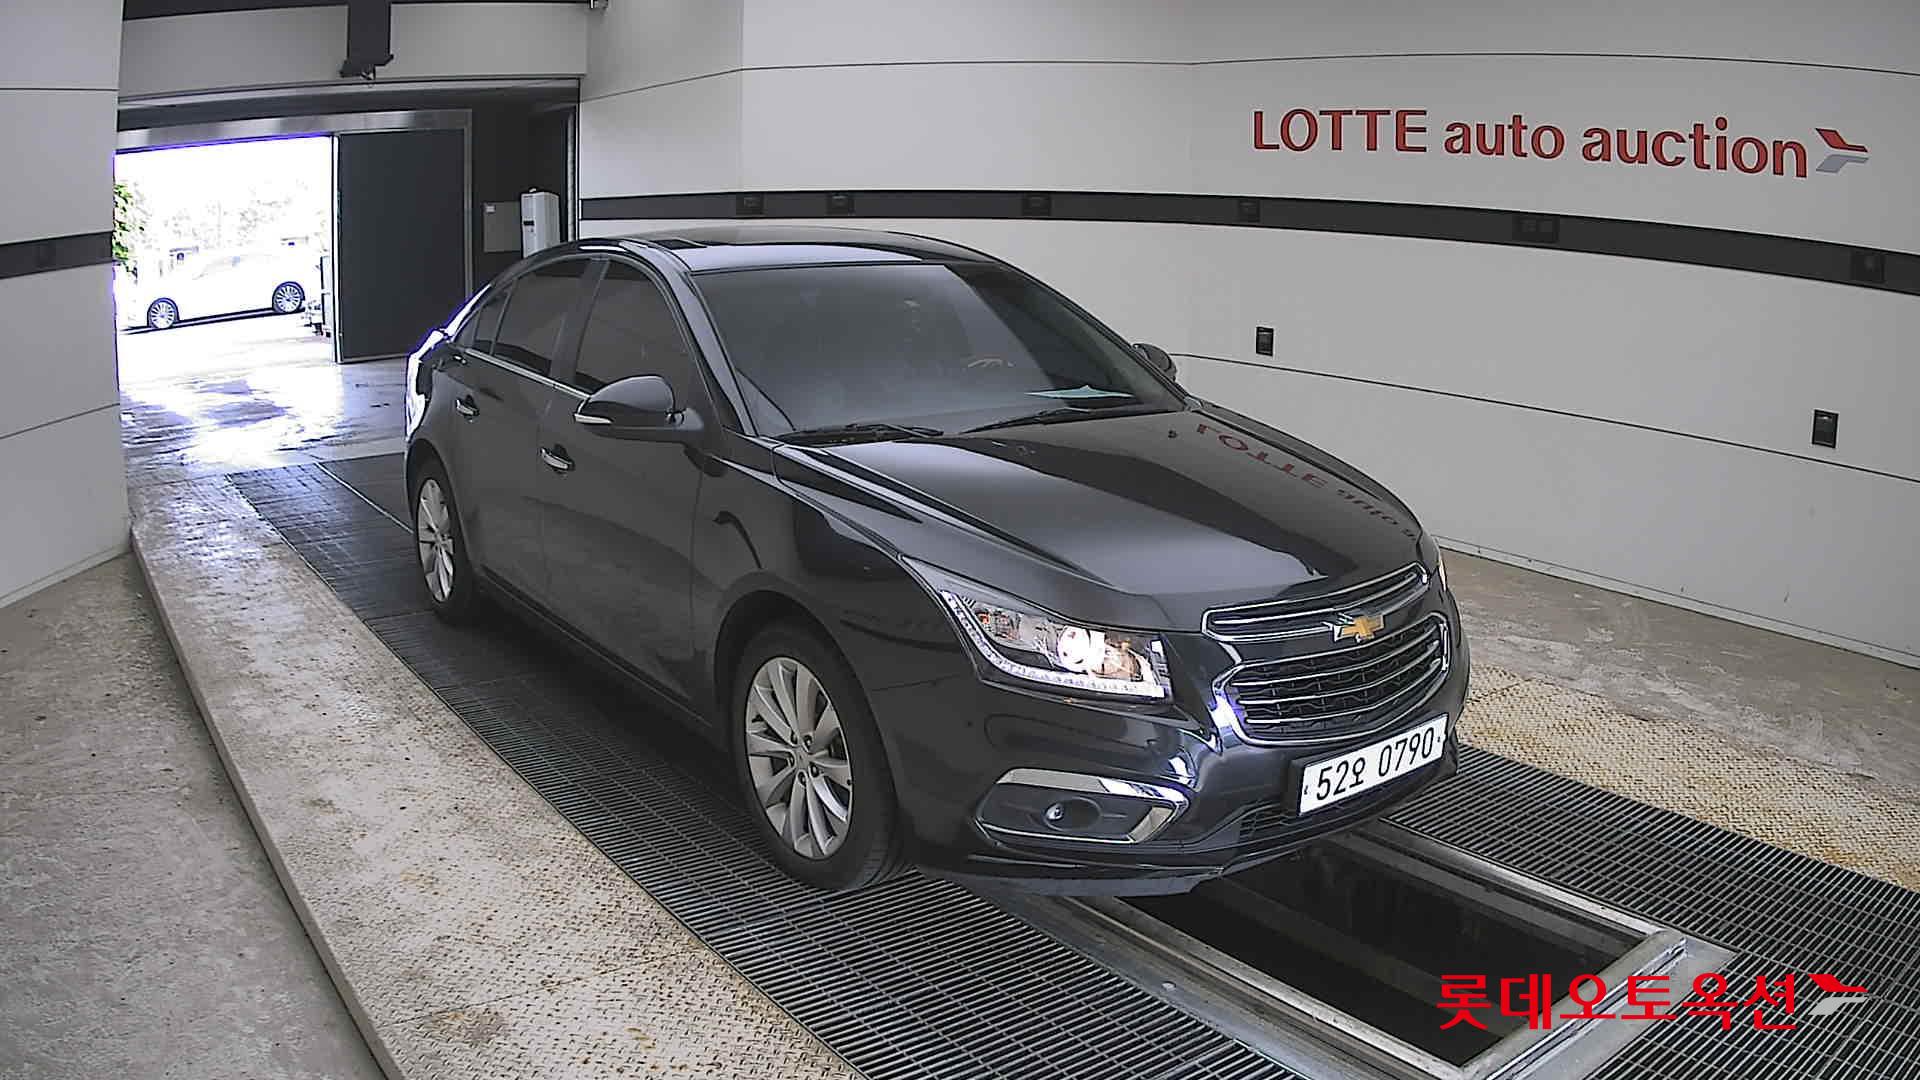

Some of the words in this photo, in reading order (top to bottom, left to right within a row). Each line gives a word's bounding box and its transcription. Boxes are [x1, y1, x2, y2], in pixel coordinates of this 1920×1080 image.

[1252, 108, 1428, 153] LOTTE
[1443, 113, 1566, 160] auto
[1581, 116, 1808, 179] auction
[1316, 756, 1366, 801] 52오
[1378, 727, 1435, 777] 0790
